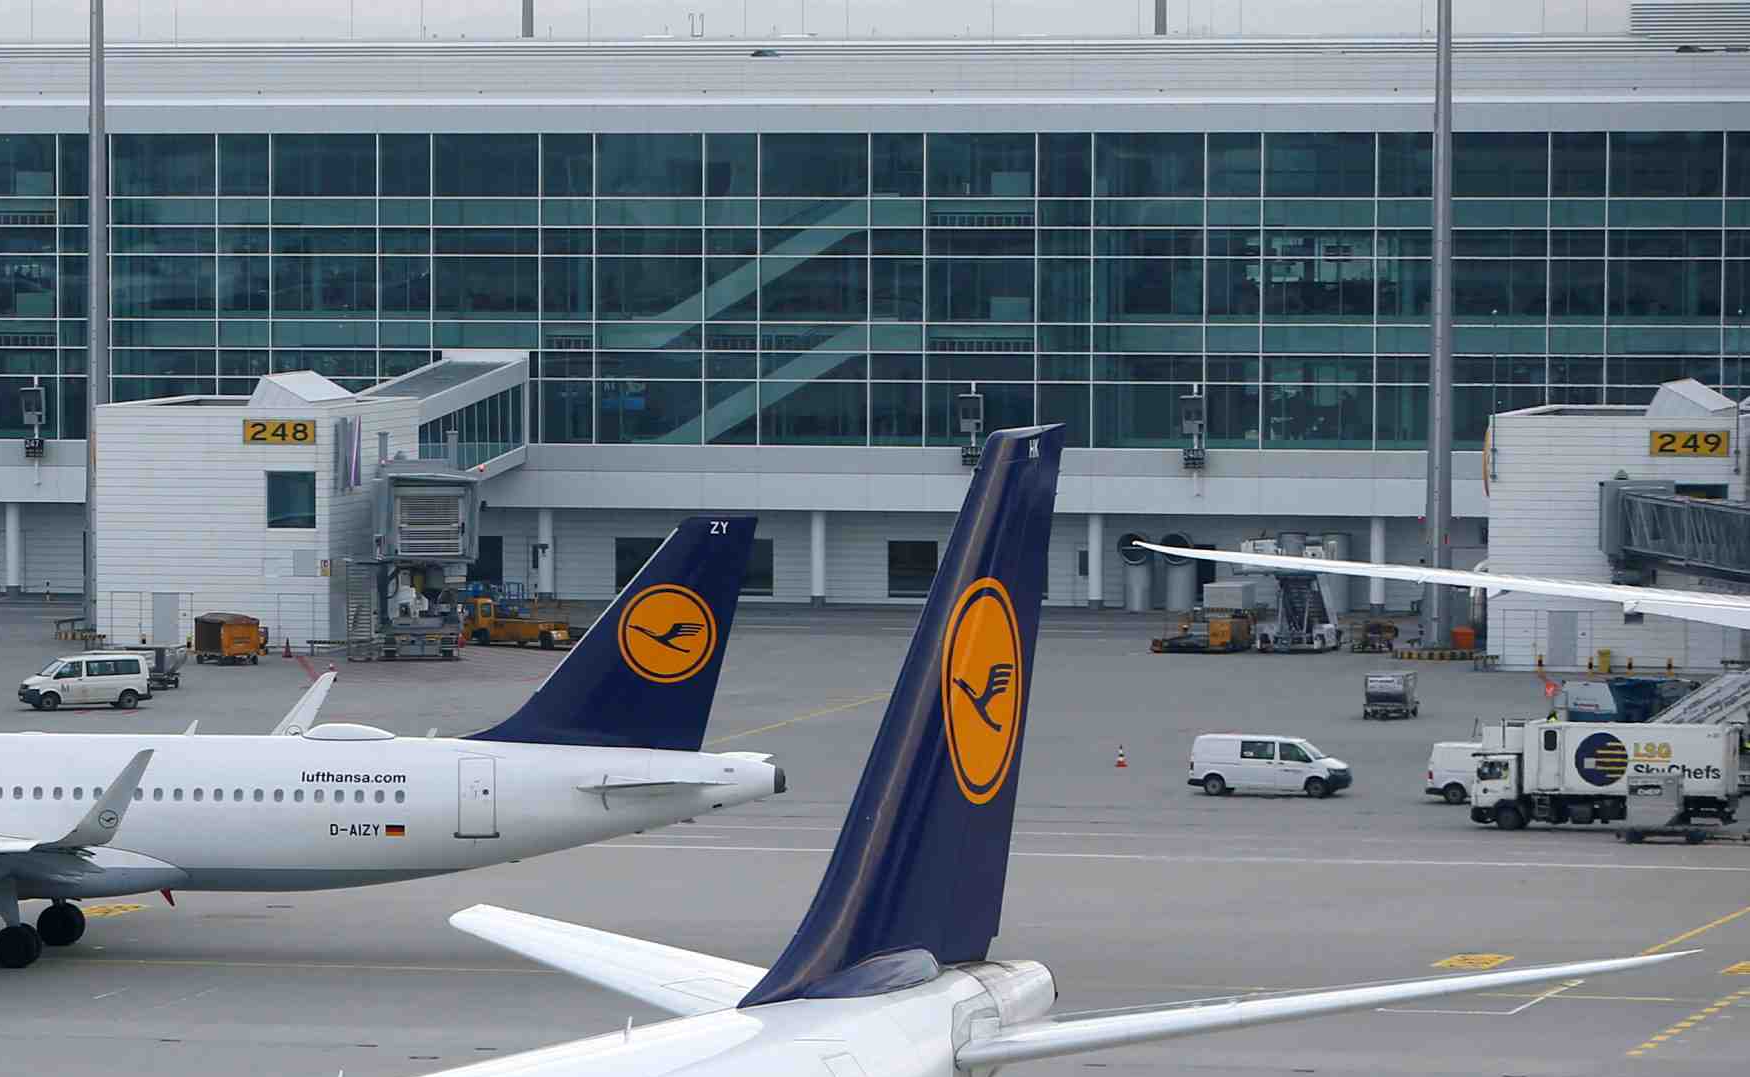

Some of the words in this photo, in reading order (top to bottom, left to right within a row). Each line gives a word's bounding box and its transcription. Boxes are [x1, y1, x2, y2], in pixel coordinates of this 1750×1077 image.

[250, 422, 309, 441] 248
[1658, 433, 1722, 452] 249
[710, 520, 729, 535] ZY
[301, 771, 406, 783] lufthansa.com
[329, 823, 380, 836] D-AIZY
